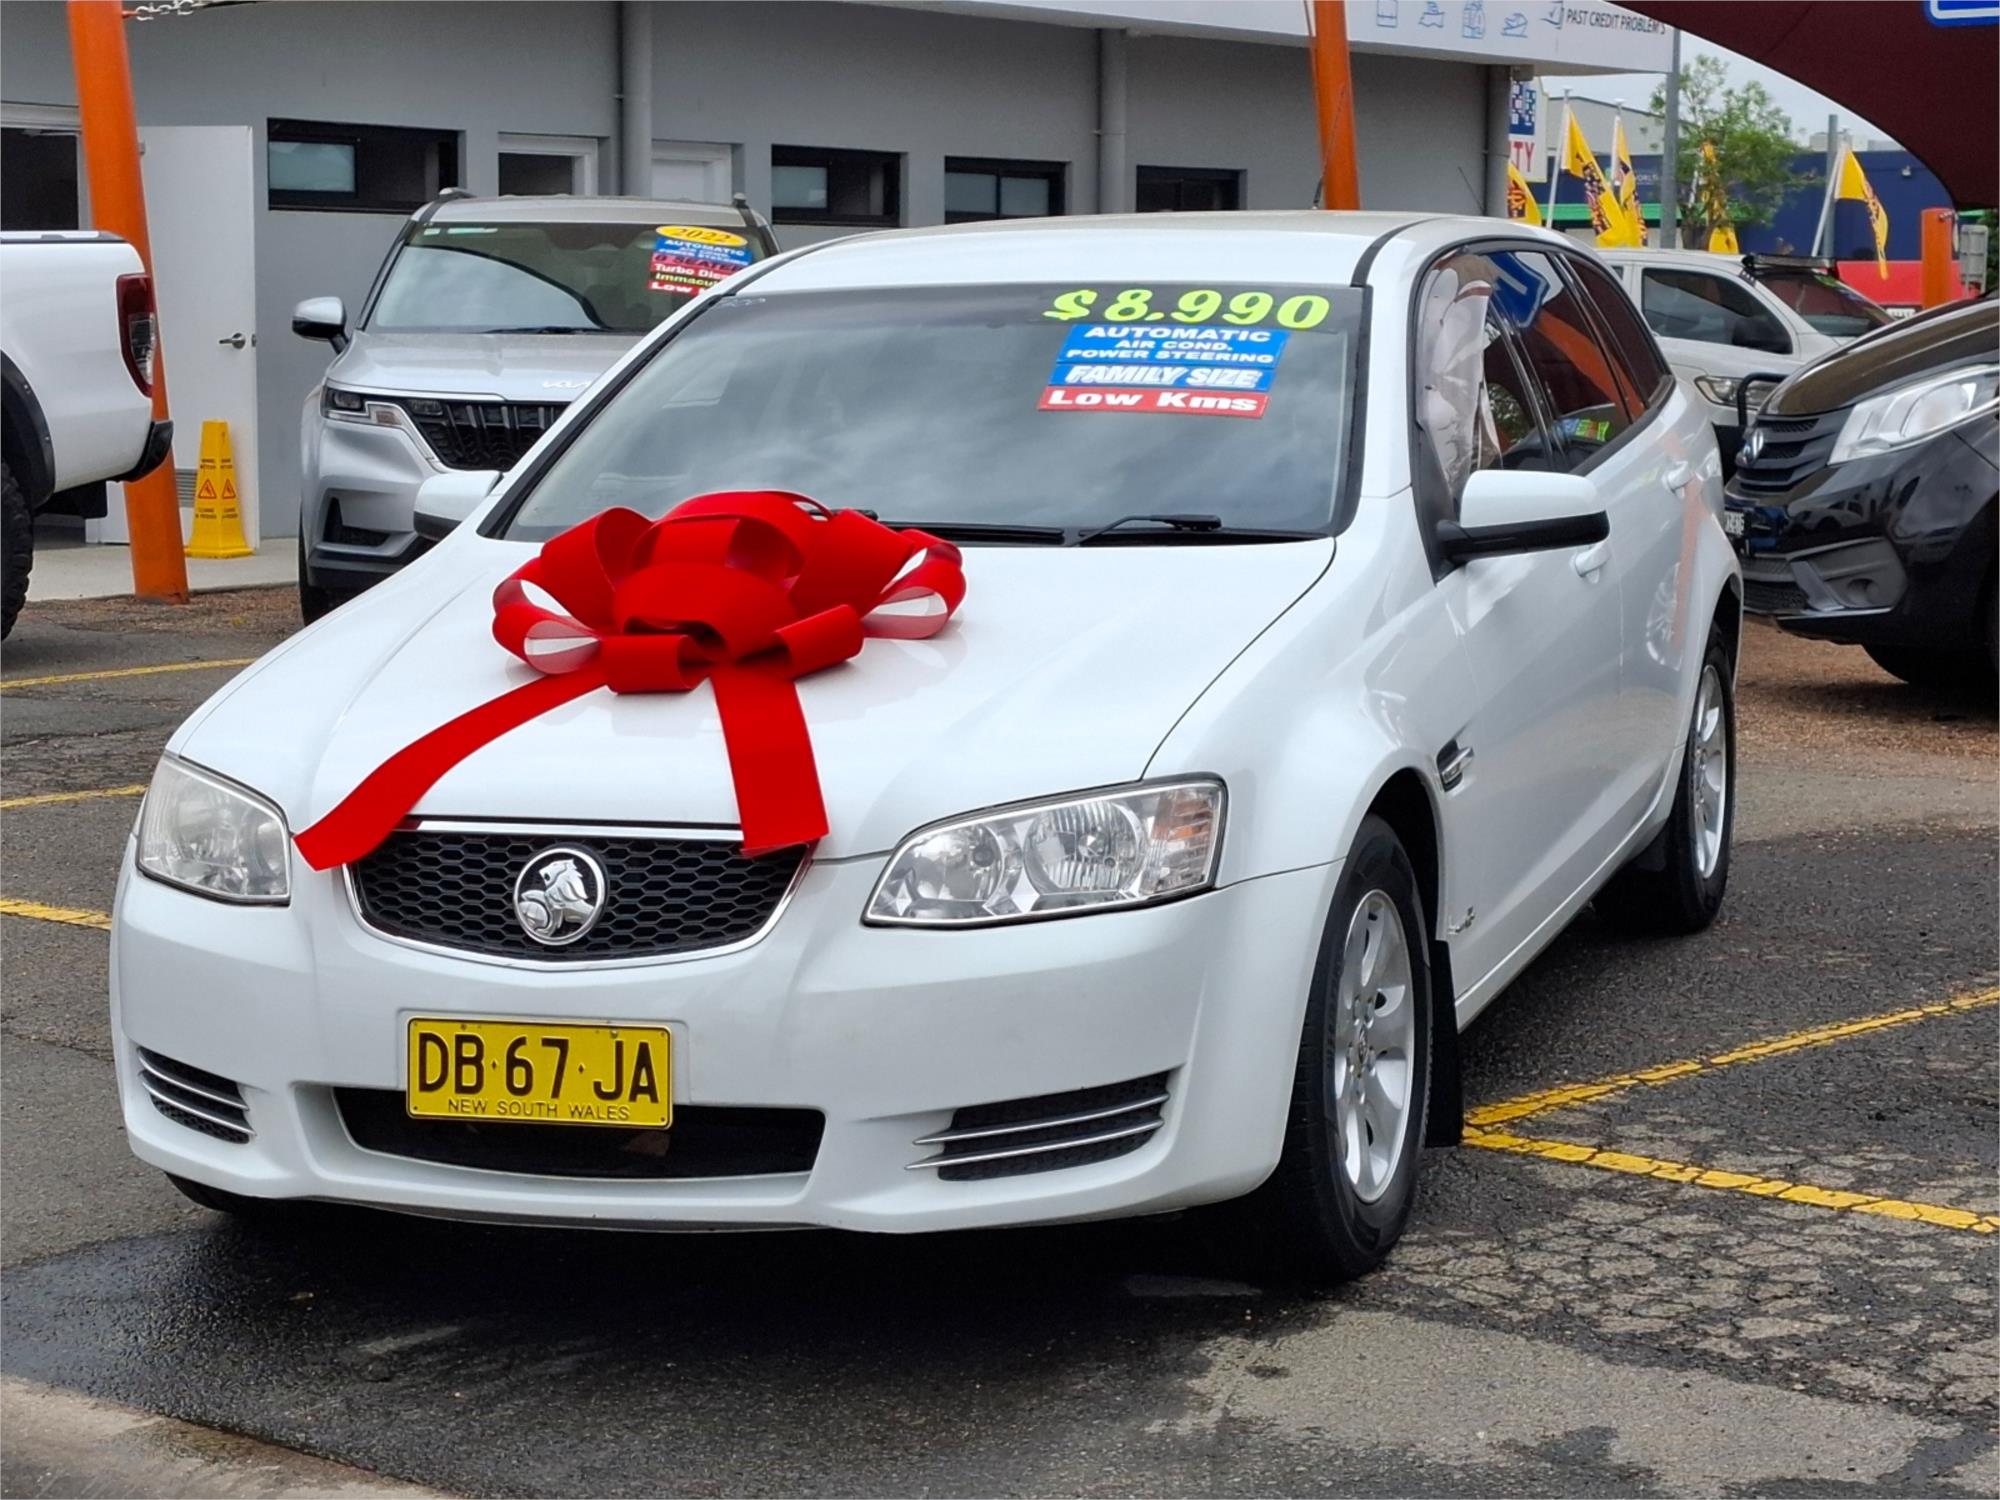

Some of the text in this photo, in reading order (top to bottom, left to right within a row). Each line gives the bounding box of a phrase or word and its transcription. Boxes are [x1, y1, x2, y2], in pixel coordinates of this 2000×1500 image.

[1567, 9, 1588, 25] PAST
[1590, 12, 1619, 29] CREDIT
[673, 228, 731, 242] 2022
[664, 240, 746, 256] AUTOMATIC
[654, 263, 695, 275] Turbo
[650, 282, 693, 293] Low
[1083, 326, 1271, 343] AUTOMATIC
[1115, 340, 1233, 351] AIR COND.
[1066, 349, 1274, 363] POWER STEERING
[1065, 364, 1263, 389] FAMILY SIZE
[1048, 390, 1258, 411] Low Kms
[448, 1098, 630, 1121] NEW SOUTH WALES
